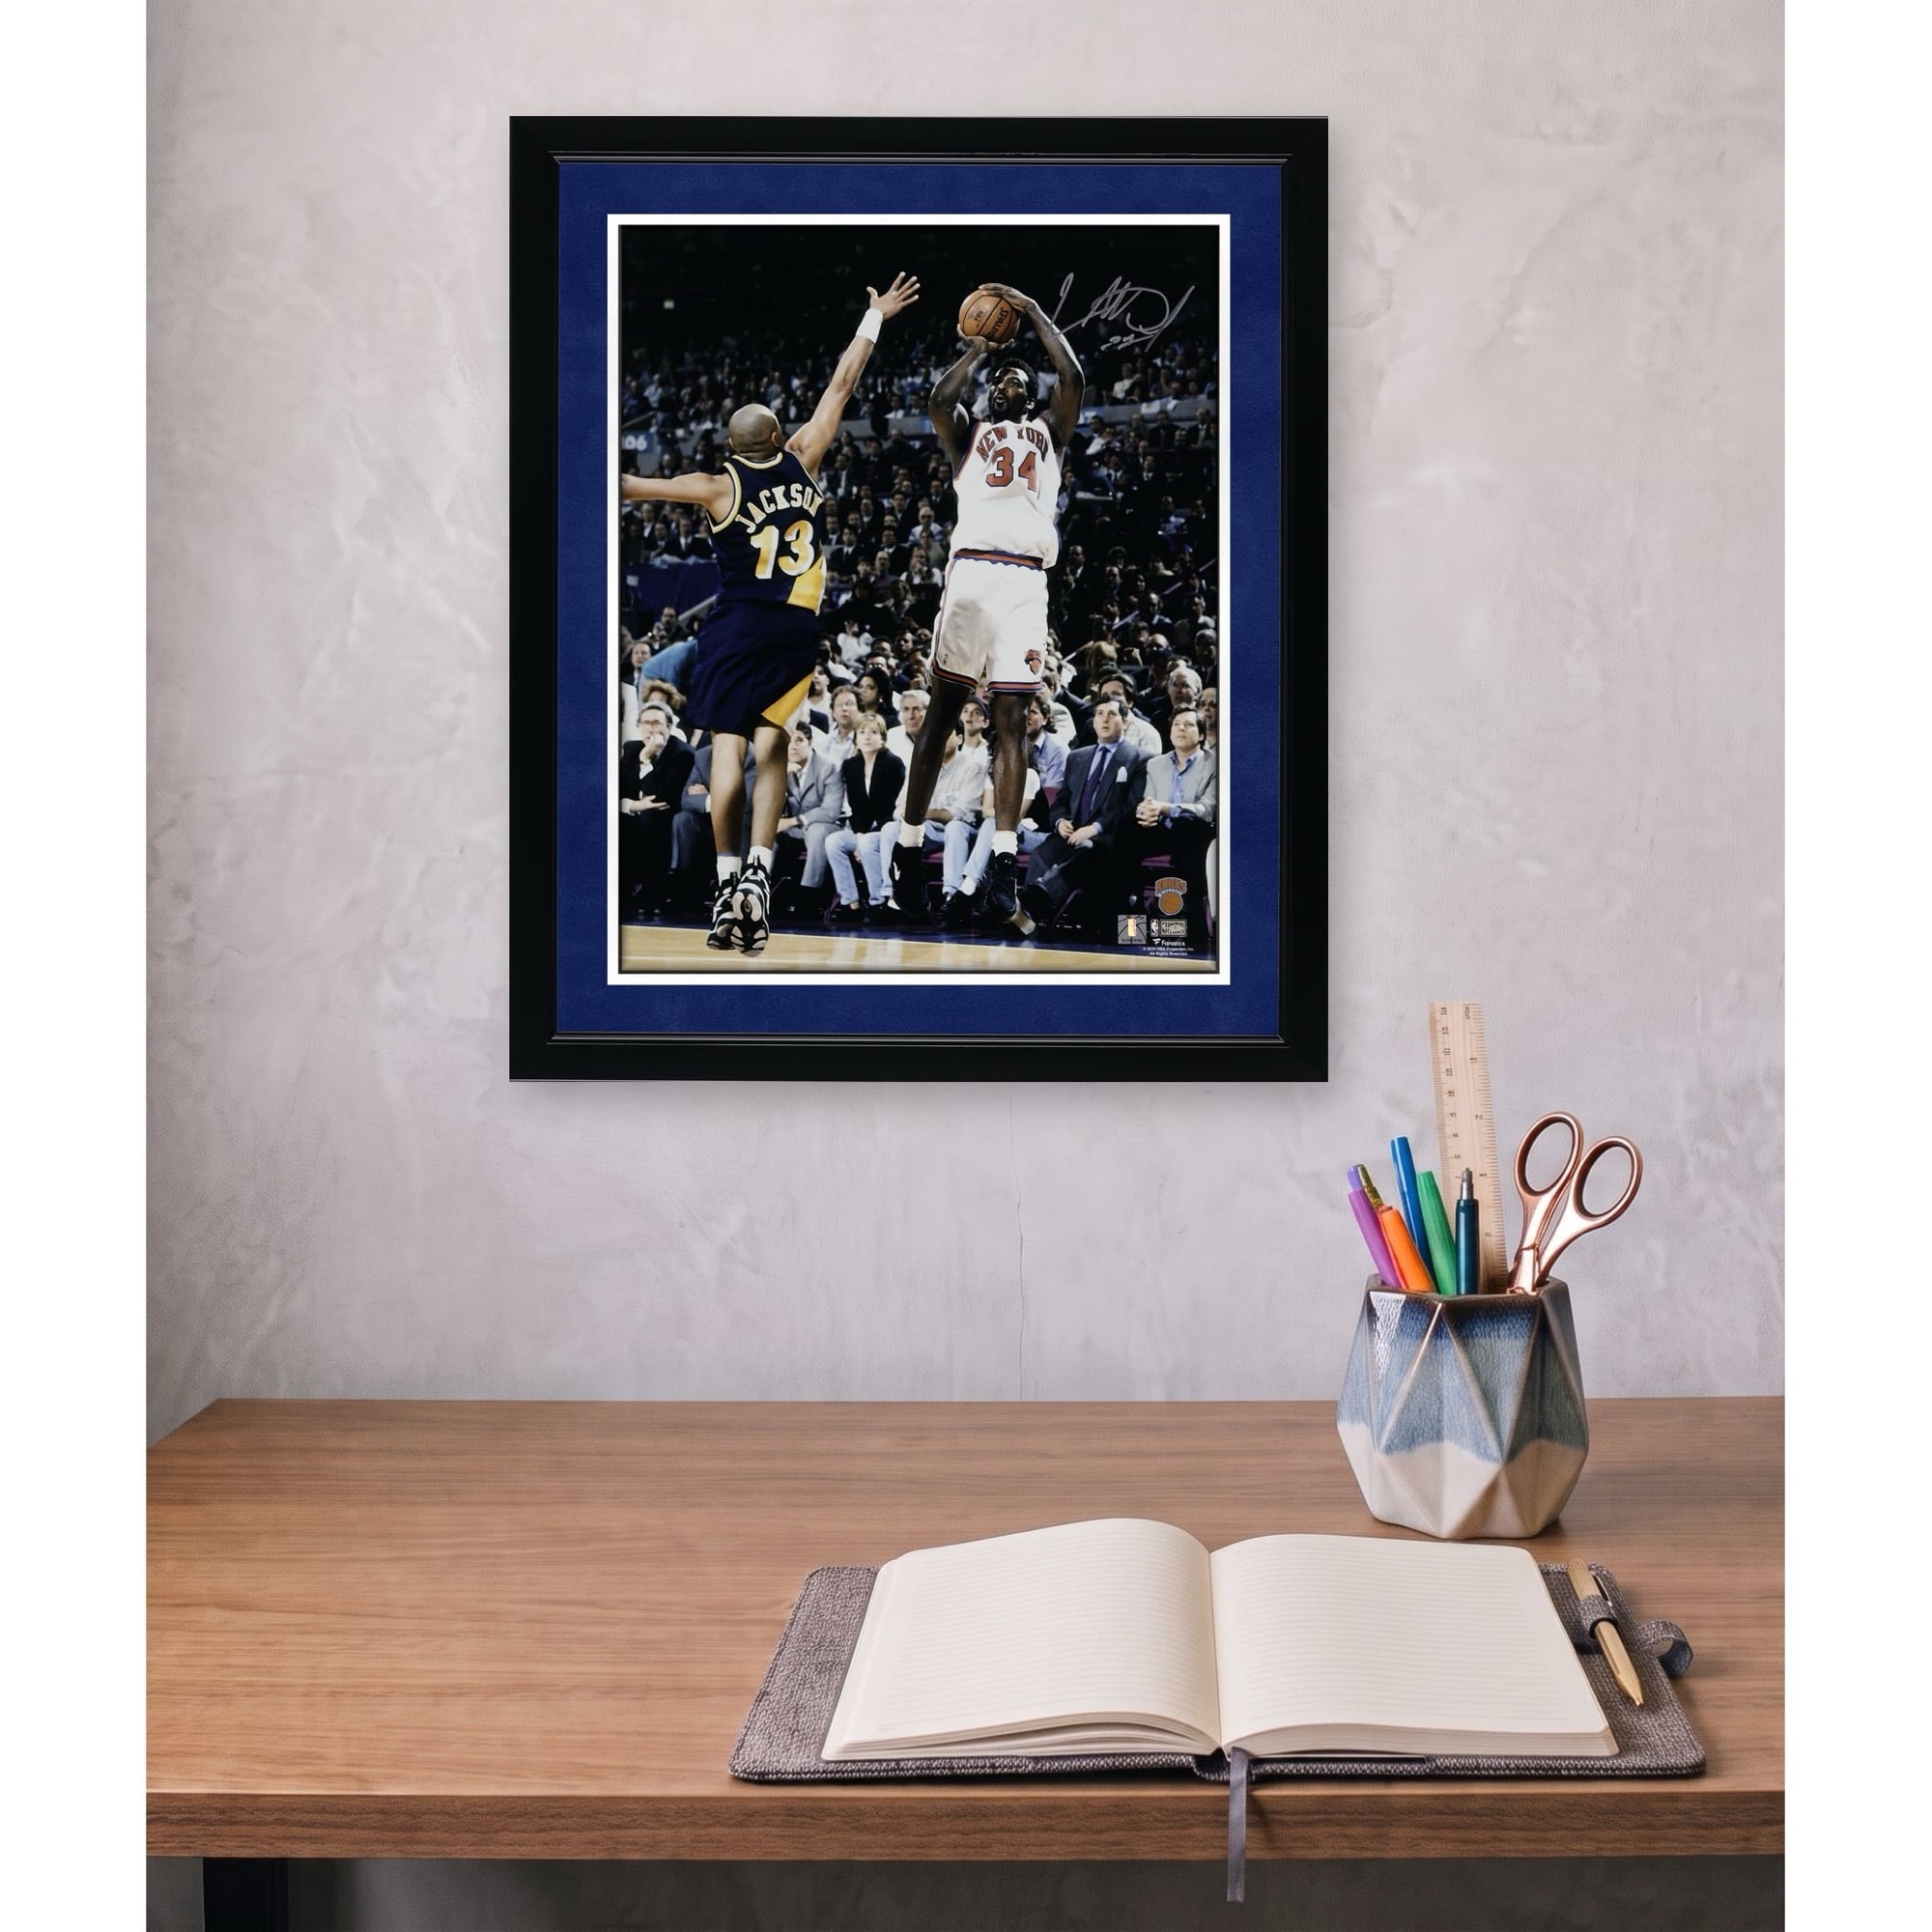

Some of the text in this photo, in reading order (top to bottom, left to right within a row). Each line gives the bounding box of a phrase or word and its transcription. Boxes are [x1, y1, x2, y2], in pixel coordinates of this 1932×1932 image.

[976, 425, 1008, 464] NEW
[985, 446, 1037, 494] 34
[750, 519, 815, 580] 13
